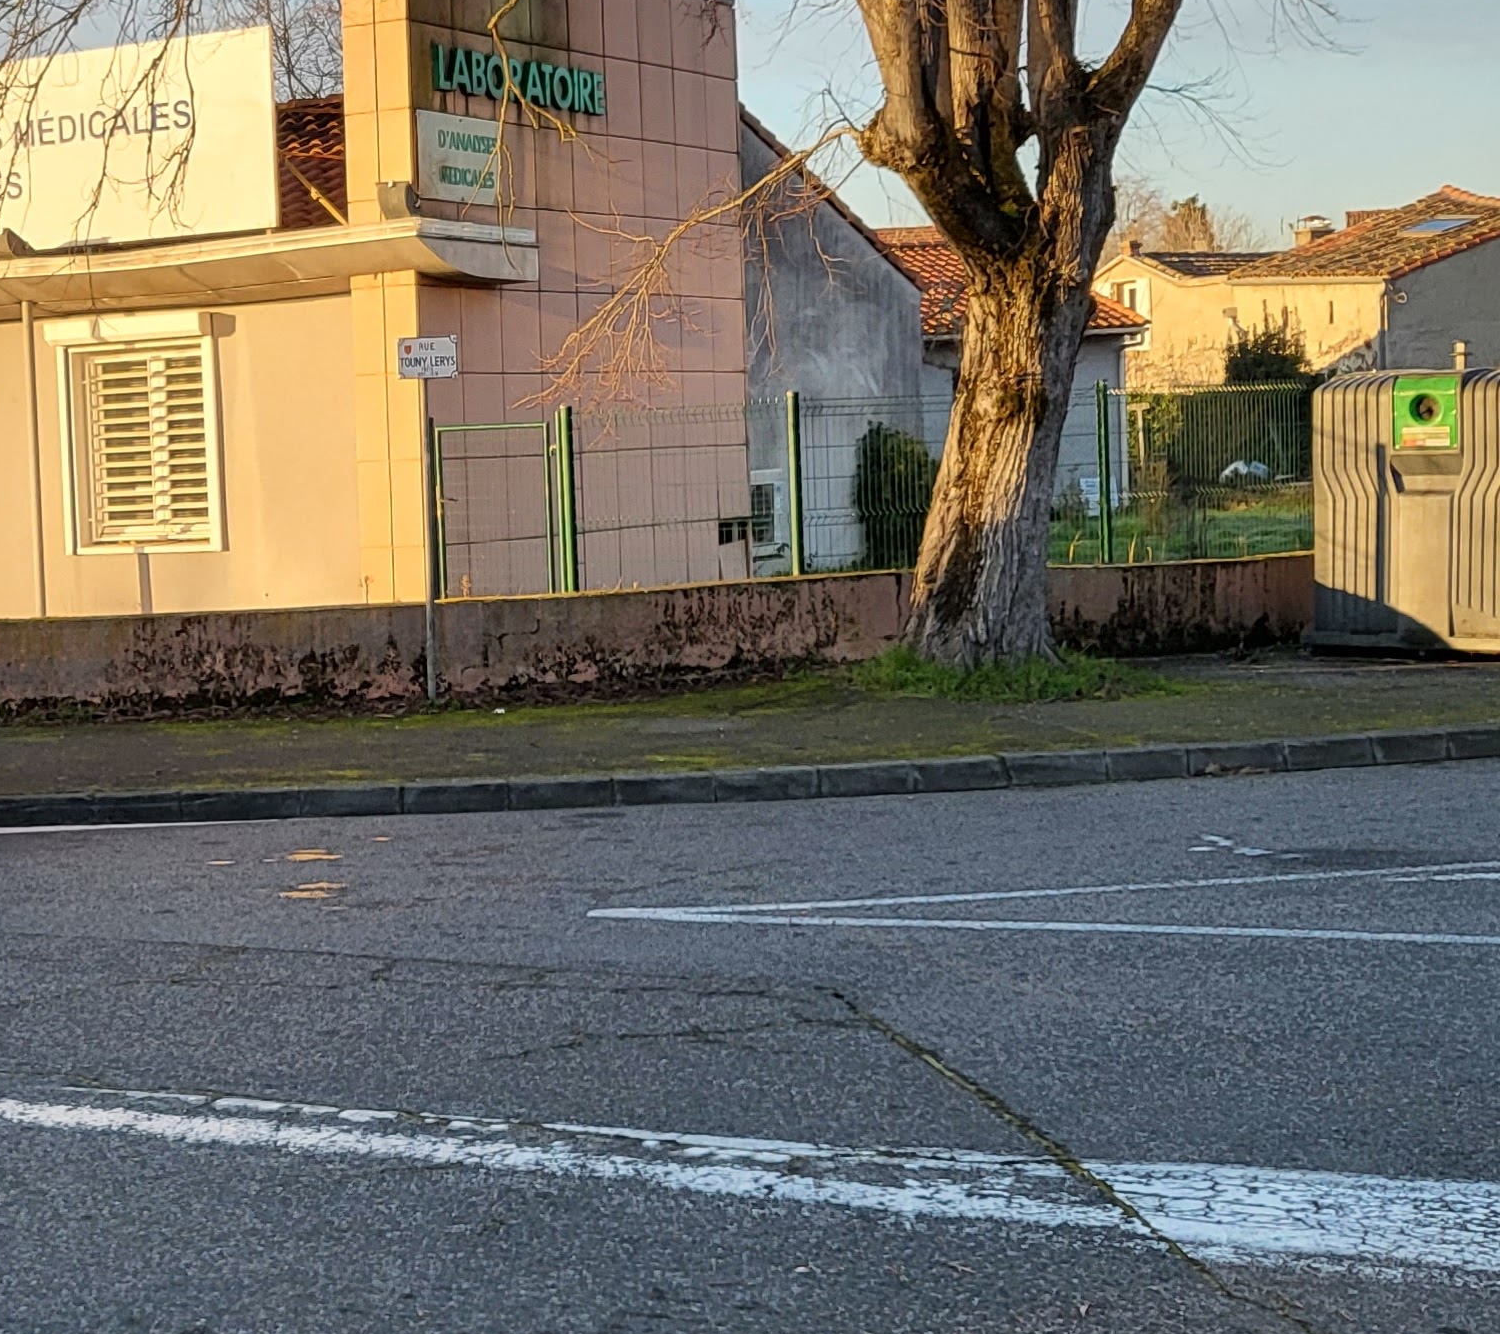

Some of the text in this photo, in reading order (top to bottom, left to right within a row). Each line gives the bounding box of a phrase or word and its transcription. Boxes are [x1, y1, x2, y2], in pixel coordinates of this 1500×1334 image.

[434, 43, 606, 115] LABORATOIRE
[14, 99, 193, 150] MÉDICALES
[400, 355, 456, 368] TOUNY LERYS
[419, 342, 436, 351] RUE
